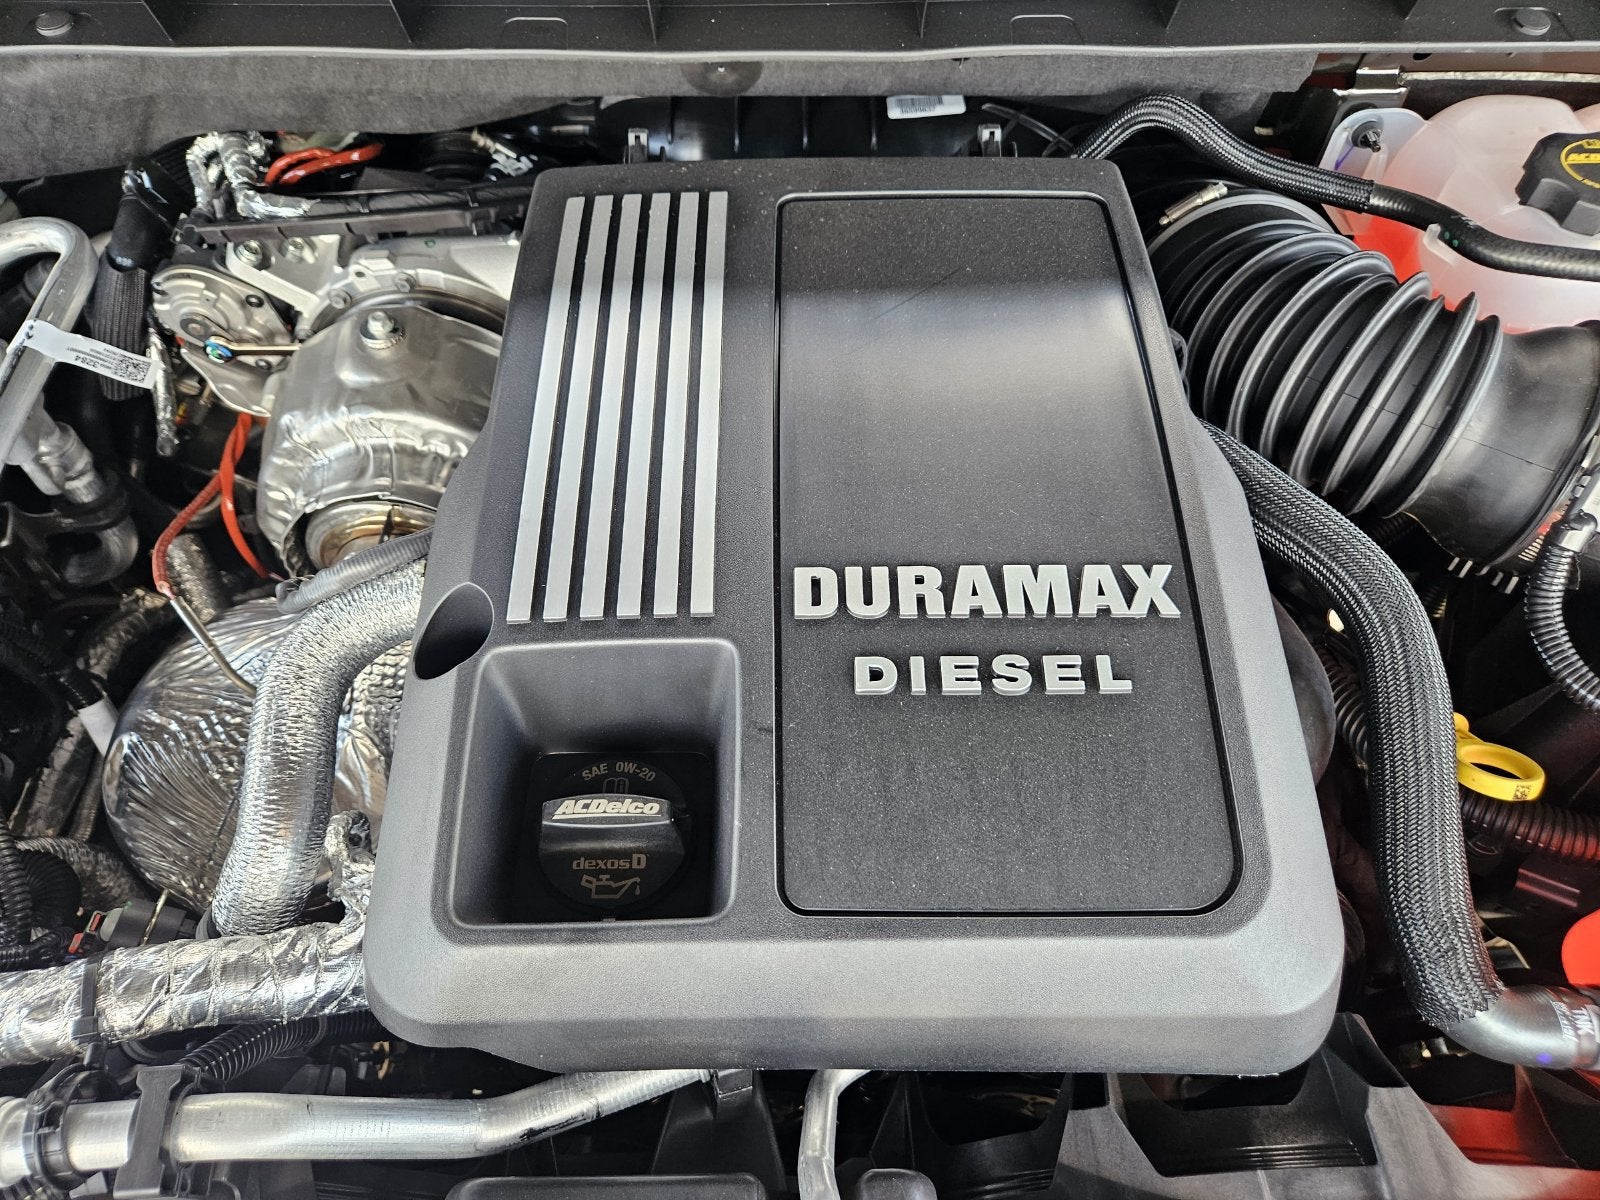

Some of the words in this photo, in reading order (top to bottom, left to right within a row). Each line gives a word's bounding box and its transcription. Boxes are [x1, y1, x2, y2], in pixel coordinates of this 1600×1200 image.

[793, 564, 1181, 619] DURAMAX
[854, 654, 1133, 695] DIESEL
[582, 763, 608, 781] SAE
[616, 761, 656, 782] 0W-20
[553, 799, 661, 816] ACDelco
[572, 853, 648, 870] dexosD
